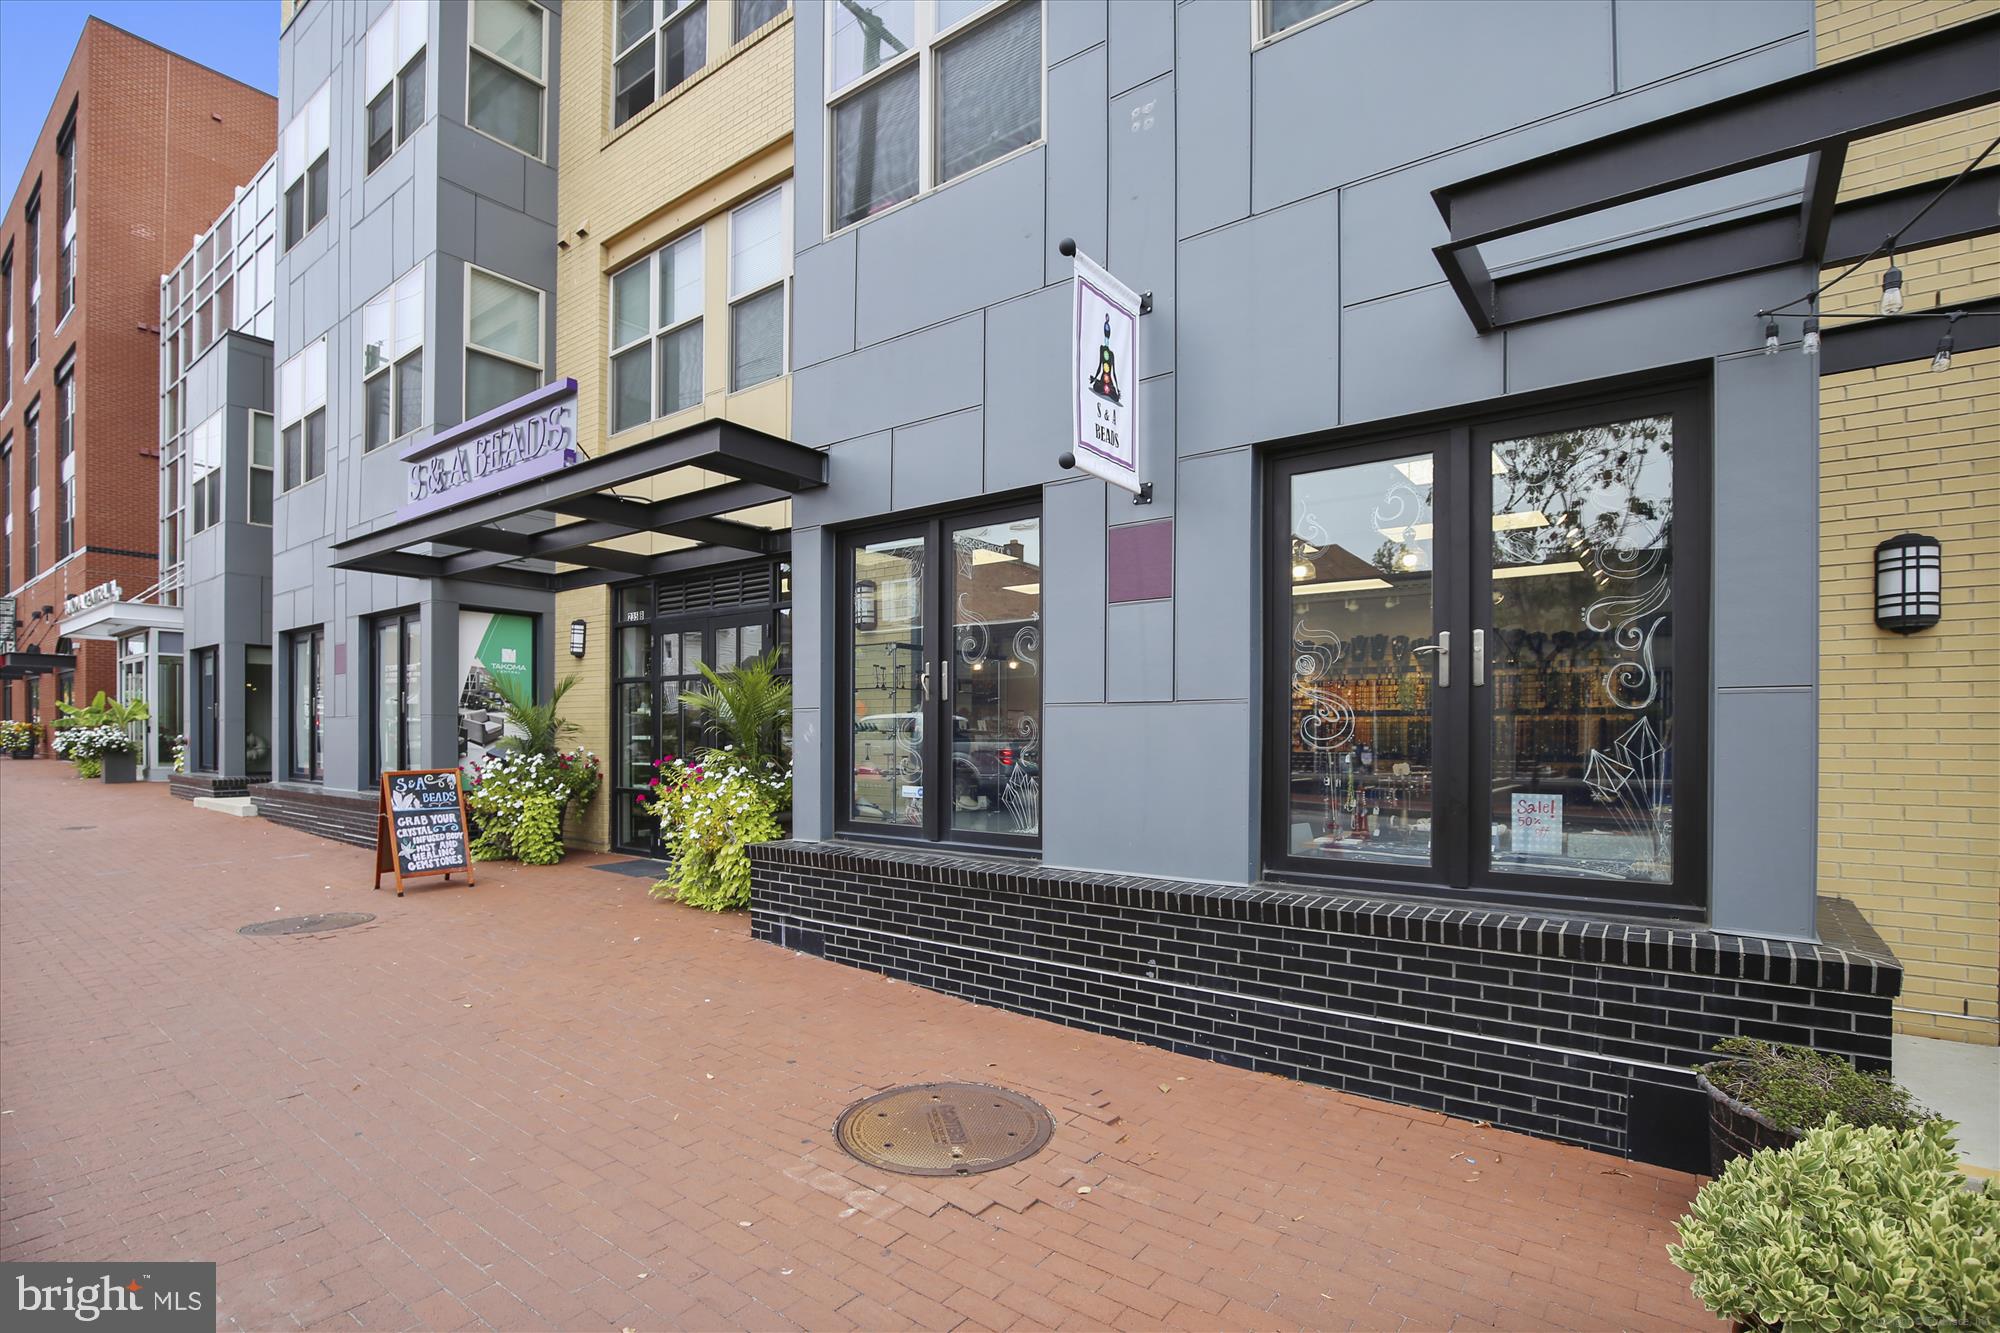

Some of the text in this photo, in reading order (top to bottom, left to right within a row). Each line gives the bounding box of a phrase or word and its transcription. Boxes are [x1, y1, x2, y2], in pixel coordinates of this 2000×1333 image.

[1096, 402, 1102, 418] S
[1103, 409, 1109, 421] &
[1095, 423, 1120, 448] BEADS
[411, 407, 571, 500] S&A BEADS
[491, 662, 527, 671] TAKOMA
[395, 777, 427, 792] S&A
[422, 791, 457, 803] BEADS
[1517, 799, 1556, 819] Sale!
[397, 813, 457, 827] GRAB YOUR
[1518, 816, 1541, 827] 50%
[396, 825, 433, 839] CRYSTAL
[412, 831, 464, 845] INFUSED BODY
[416, 840, 458, 854] MIST AND
[411, 847, 456, 862] HEALING
[407, 855, 463, 871] GEMSTONES
